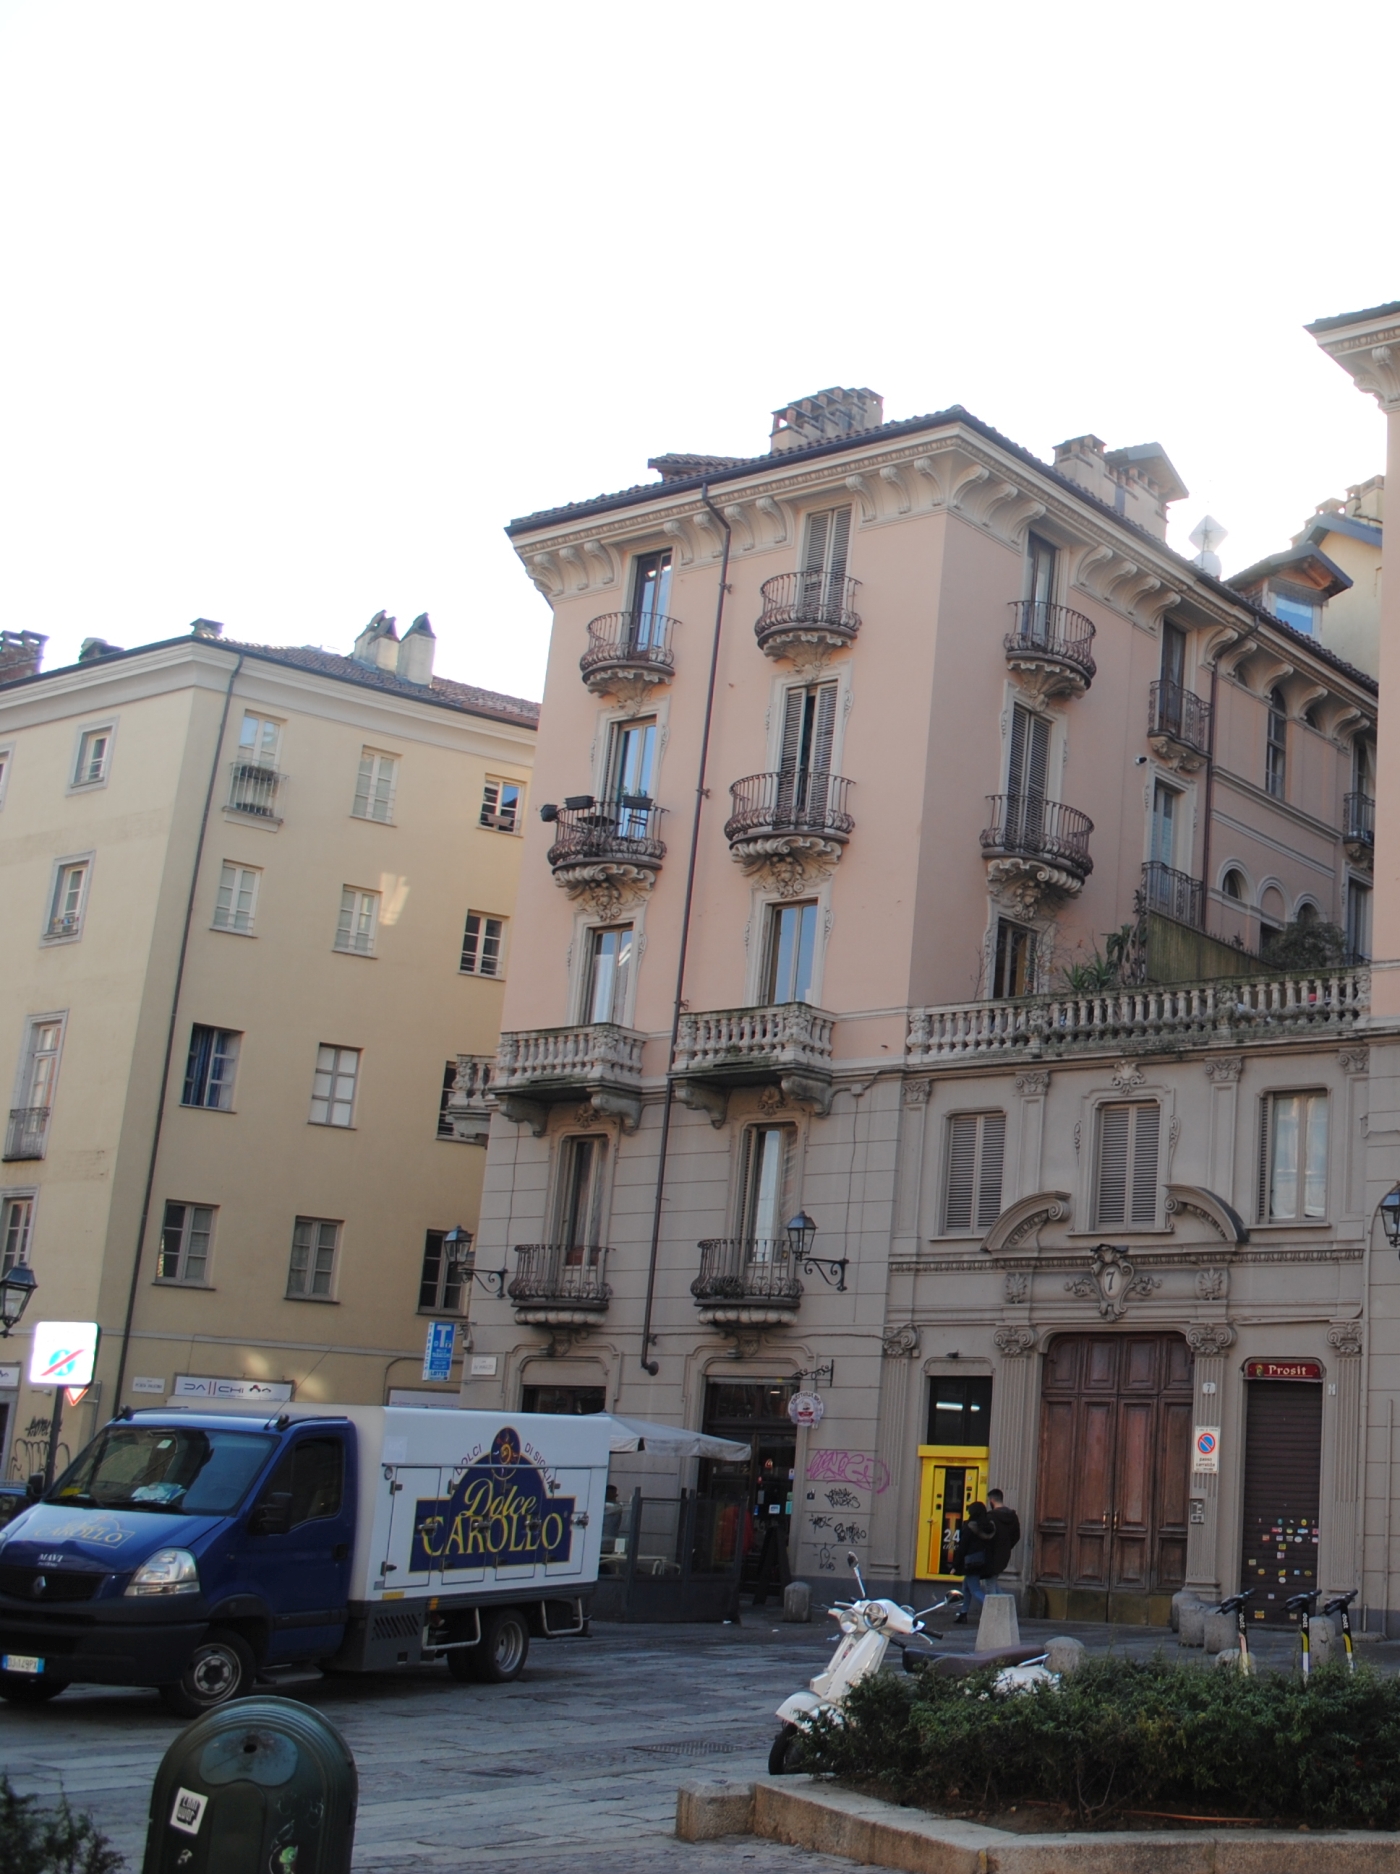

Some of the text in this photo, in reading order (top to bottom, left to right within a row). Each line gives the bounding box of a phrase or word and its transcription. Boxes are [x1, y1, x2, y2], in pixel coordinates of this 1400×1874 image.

[1105, 1270, 1116, 1292] 7
[1268, 1364, 1307, 1376] Prosit
[459, 1477, 537, 1518] Dolce
[421, 1513, 563, 1557] CAROLLO
[943, 1528, 961, 1543] 24
[37, 1553, 64, 1563] MAVI
[1238, 1612, 1246, 1629] dott
[1341, 1613, 1349, 1629] dott
